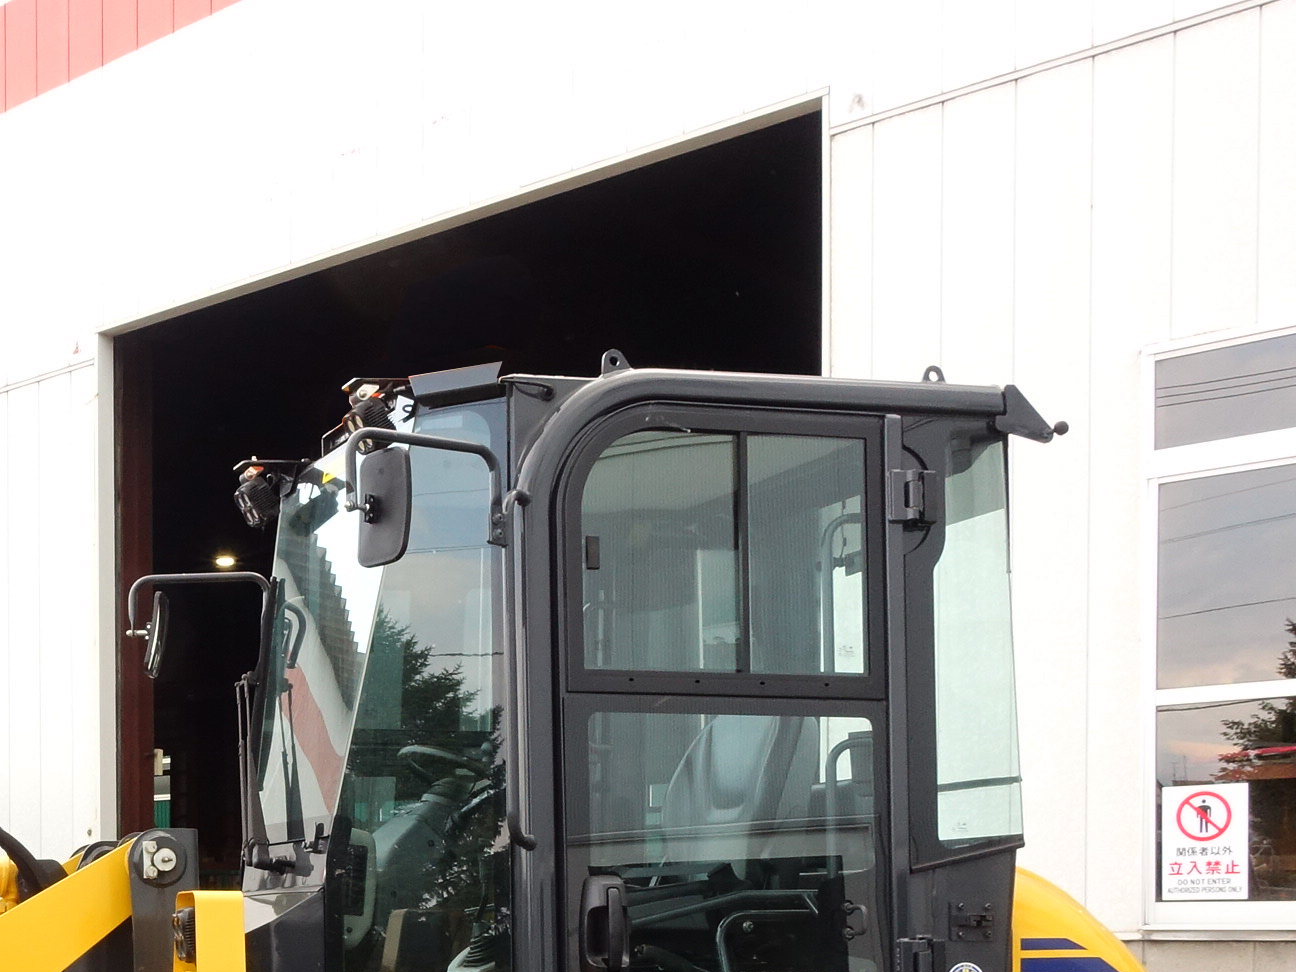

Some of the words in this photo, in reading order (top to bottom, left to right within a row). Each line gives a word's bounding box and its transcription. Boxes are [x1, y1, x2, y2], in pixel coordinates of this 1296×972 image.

[1176, 846, 1233, 857] 関係者以外
[1168, 860, 1241, 875] 立入禁止
